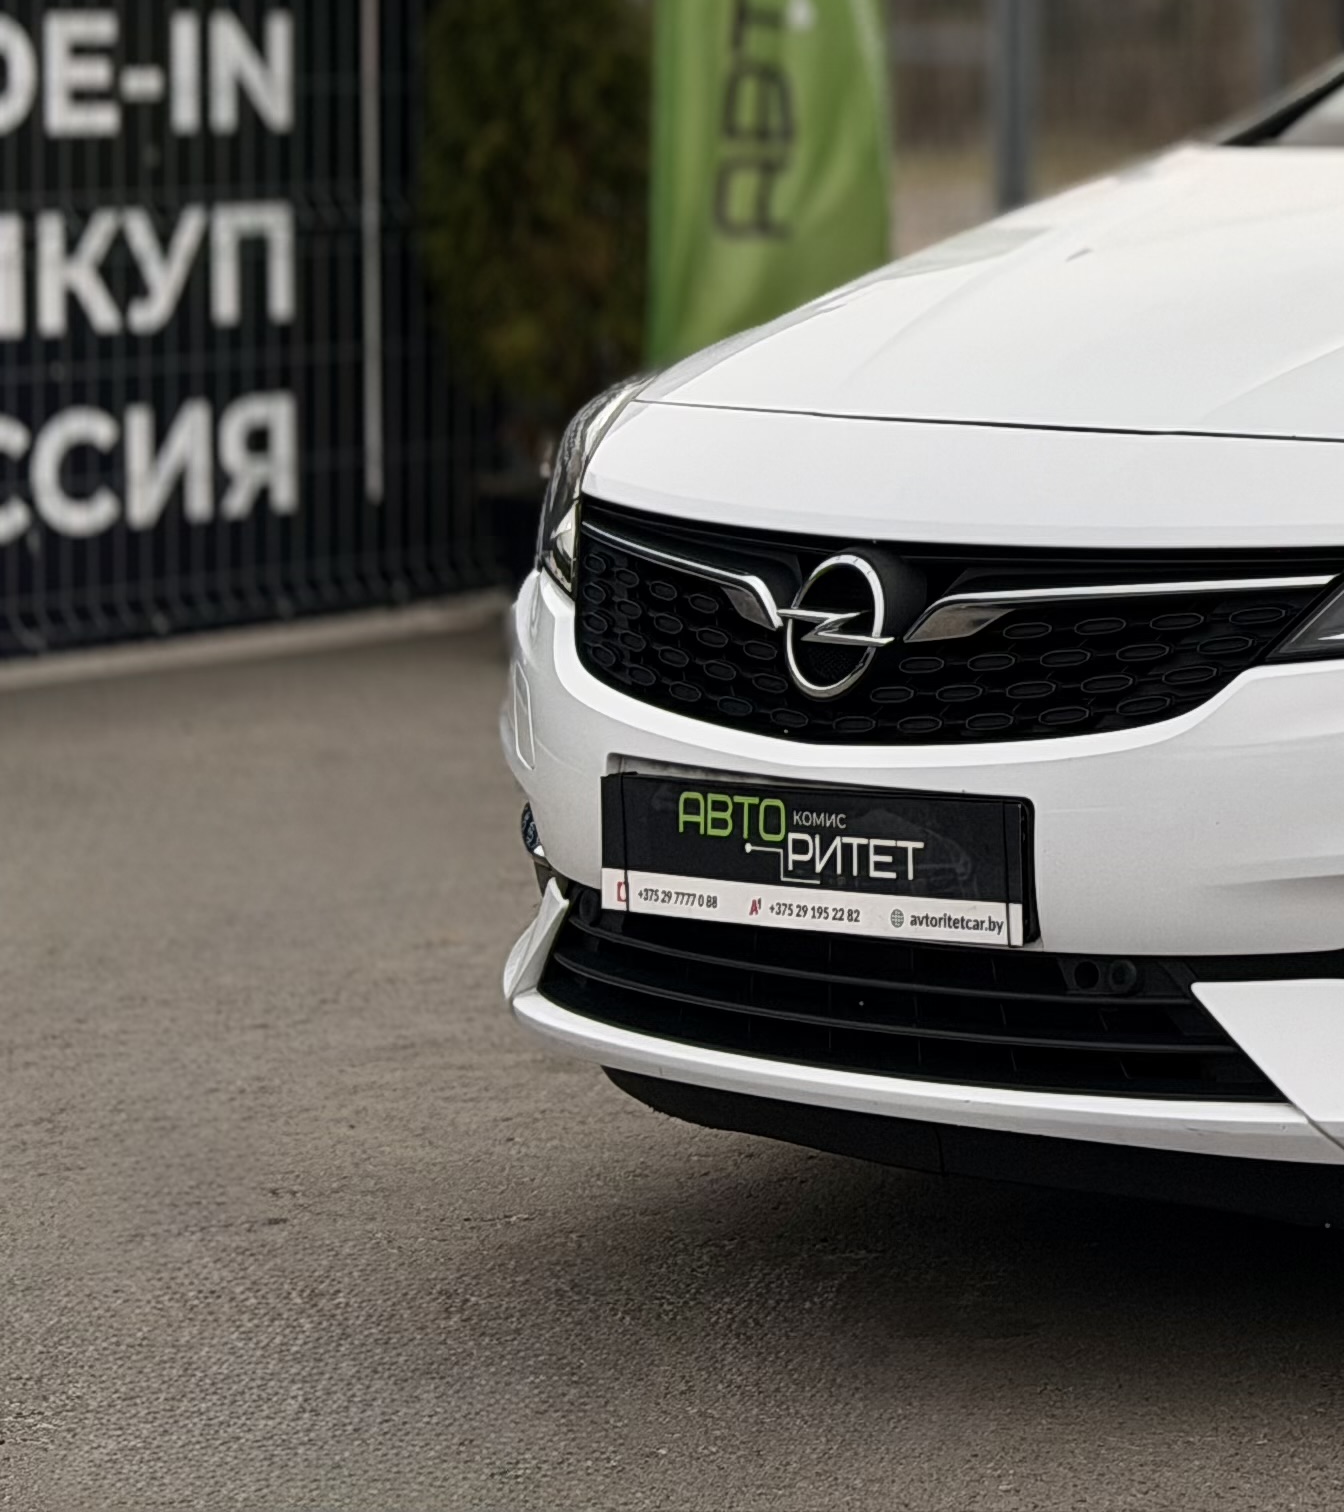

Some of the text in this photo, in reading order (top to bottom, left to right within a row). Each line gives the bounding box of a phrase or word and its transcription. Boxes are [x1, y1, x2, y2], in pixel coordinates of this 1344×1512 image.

[678, 791, 787, 842] АВТО
[792, 810, 847, 829] КОМИС
[787, 831, 925, 881] РИТЕТ
[638, 888, 659, 903] +375
[661, 890, 672, 904] 29
[769, 902, 793, 917] +375
[795, 904, 808, 918] 29
[810, 906, 830, 920] 195
[831, 908, 845, 922] 22
[847, 909, 861, 923] 82
[909, 912, 1004, 936] avtoritetcar.by
